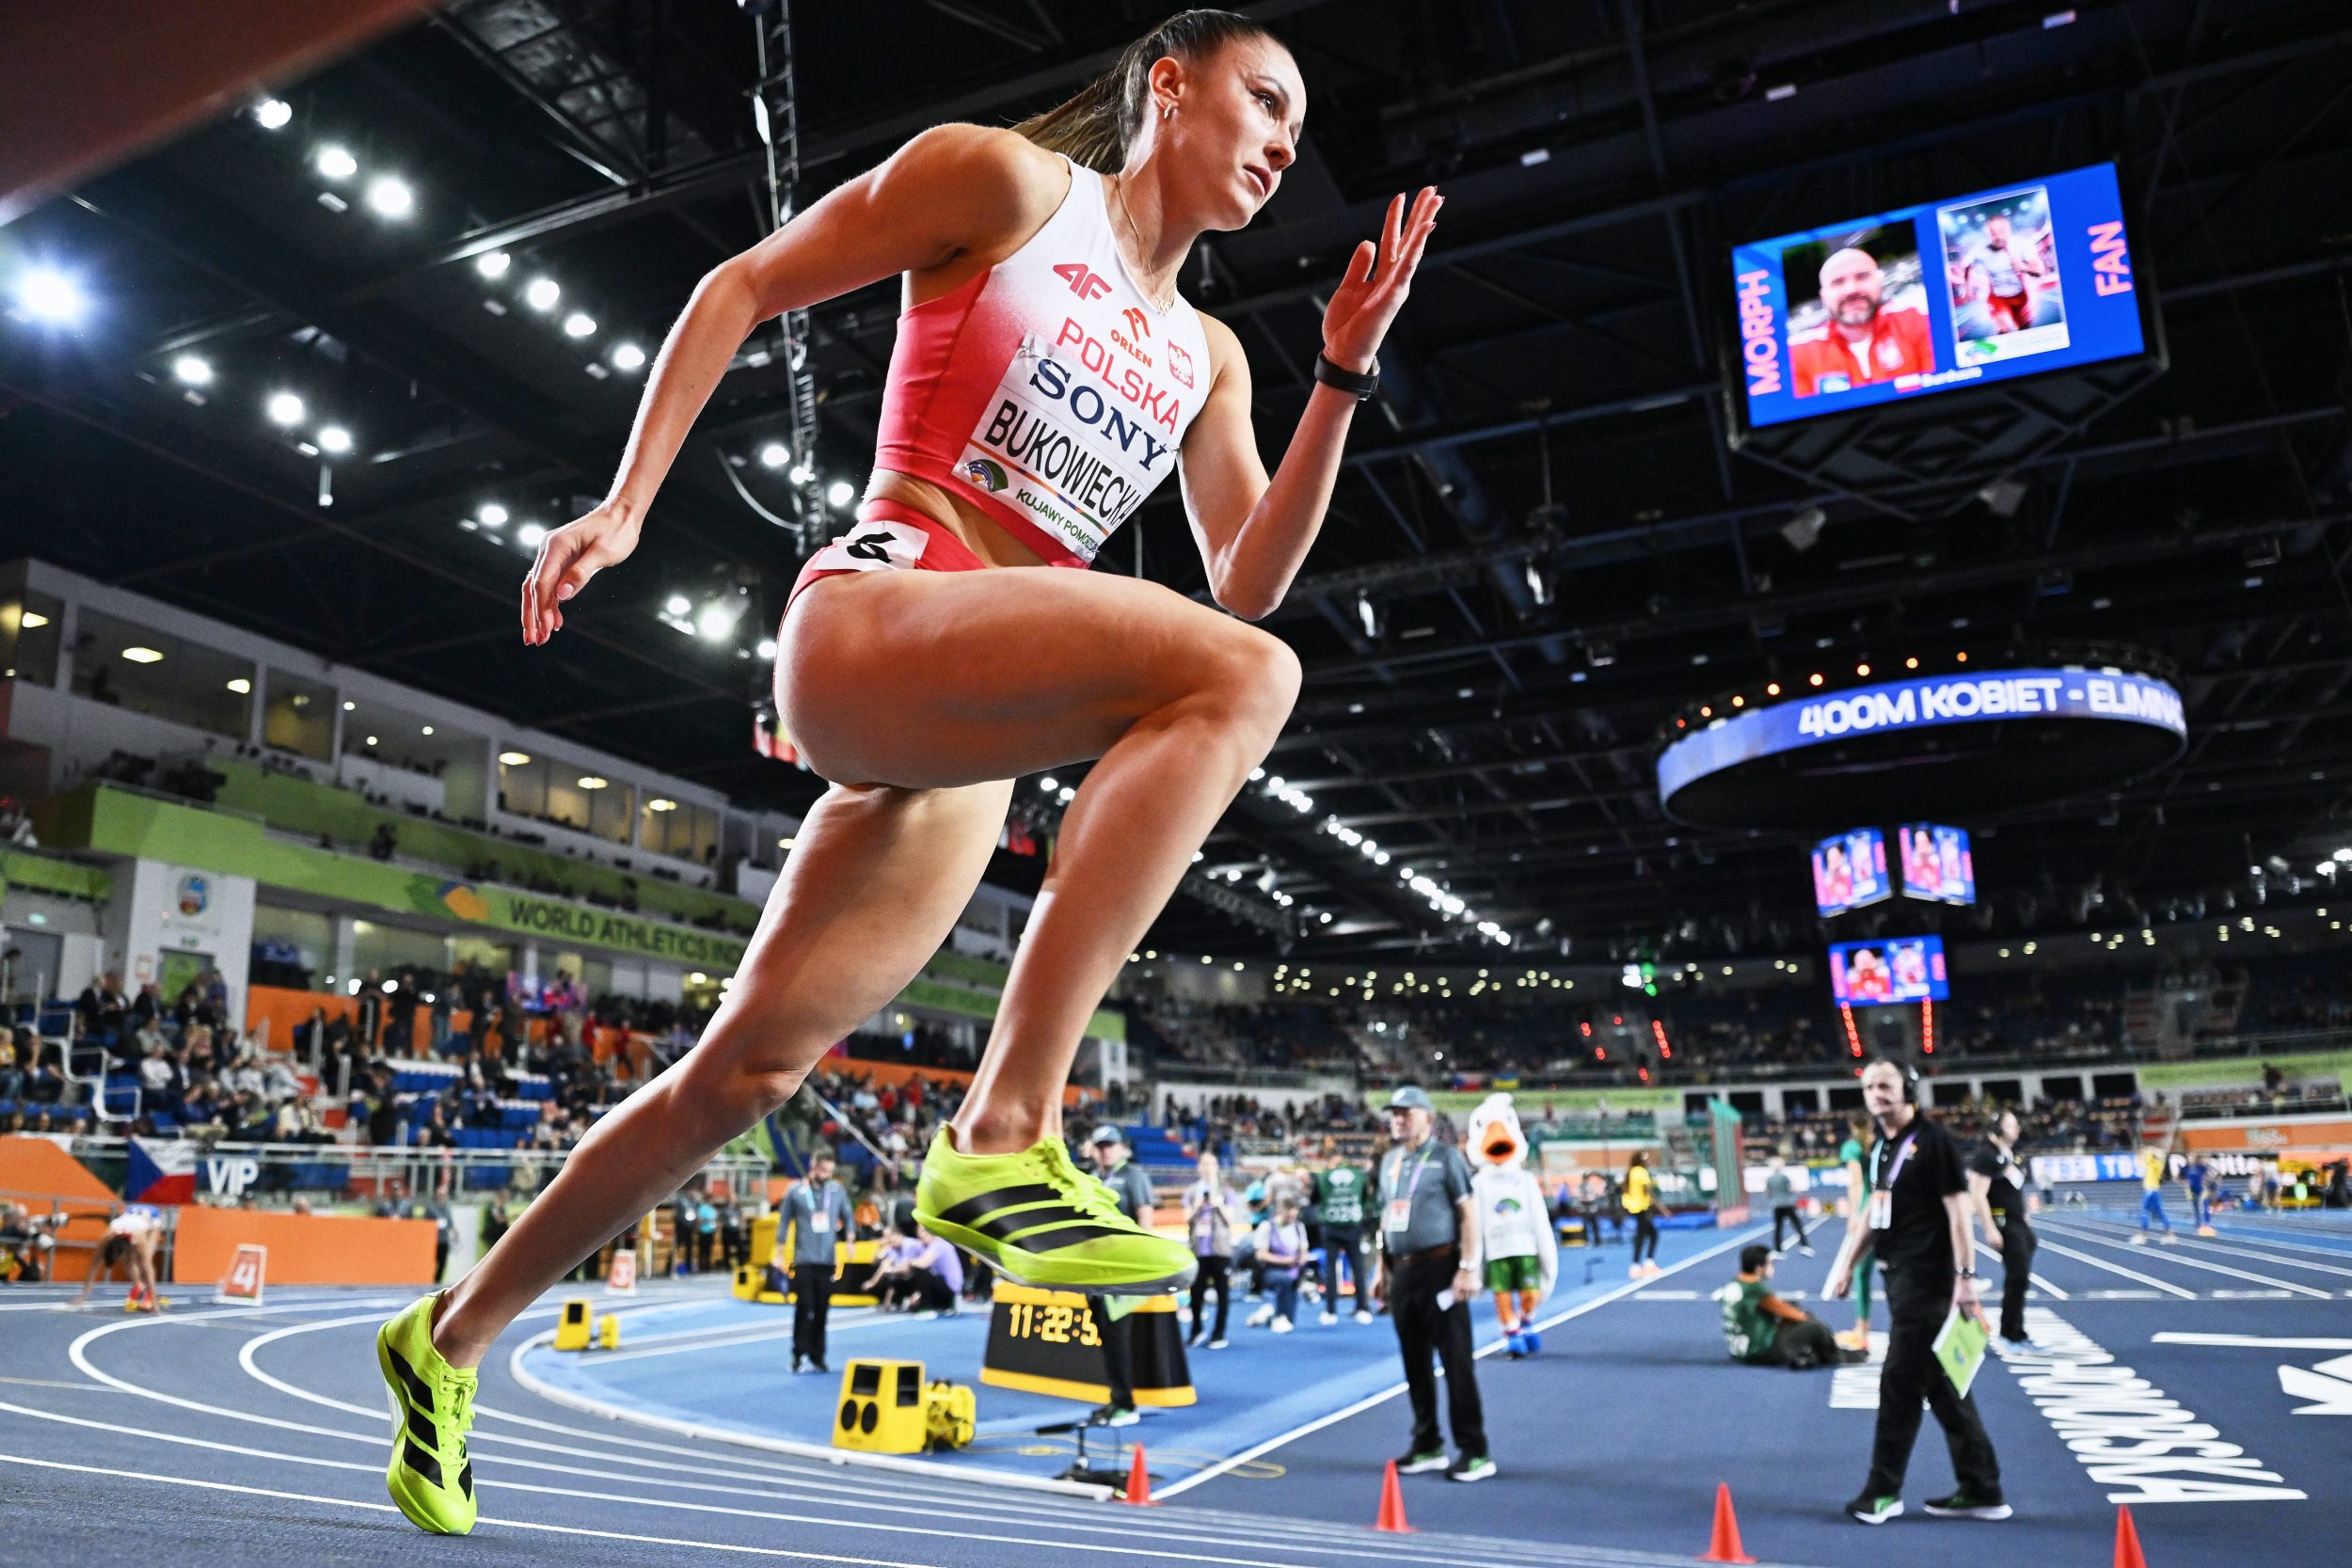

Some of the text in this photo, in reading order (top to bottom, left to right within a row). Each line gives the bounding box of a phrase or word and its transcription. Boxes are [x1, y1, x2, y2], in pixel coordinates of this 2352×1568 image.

[1053, 263, 1113, 301] 4F
[2089, 220, 2133, 297] FAN
[1110, 329, 1152, 368] ORLEN
[1737, 269, 1782, 396] MORPH
[1057, 317, 1181, 435] POLSKA
[1029, 358, 1168, 471] SONY
[984, 399, 1141, 529] BUKOWIECKA
[1016, 488, 1065, 525] KUJAWY
[1799, 689, 1917, 737] 400M
[1920, 677, 2063, 721] KOBIET
[510, 898, 595, 937] WORLD
[599, 918, 707, 959] ATHLETICS
[208, 1158, 260, 1196] VIP
[232, 1262, 257, 1292] 4
[1009, 1304, 1103, 1347] 11:22:5
